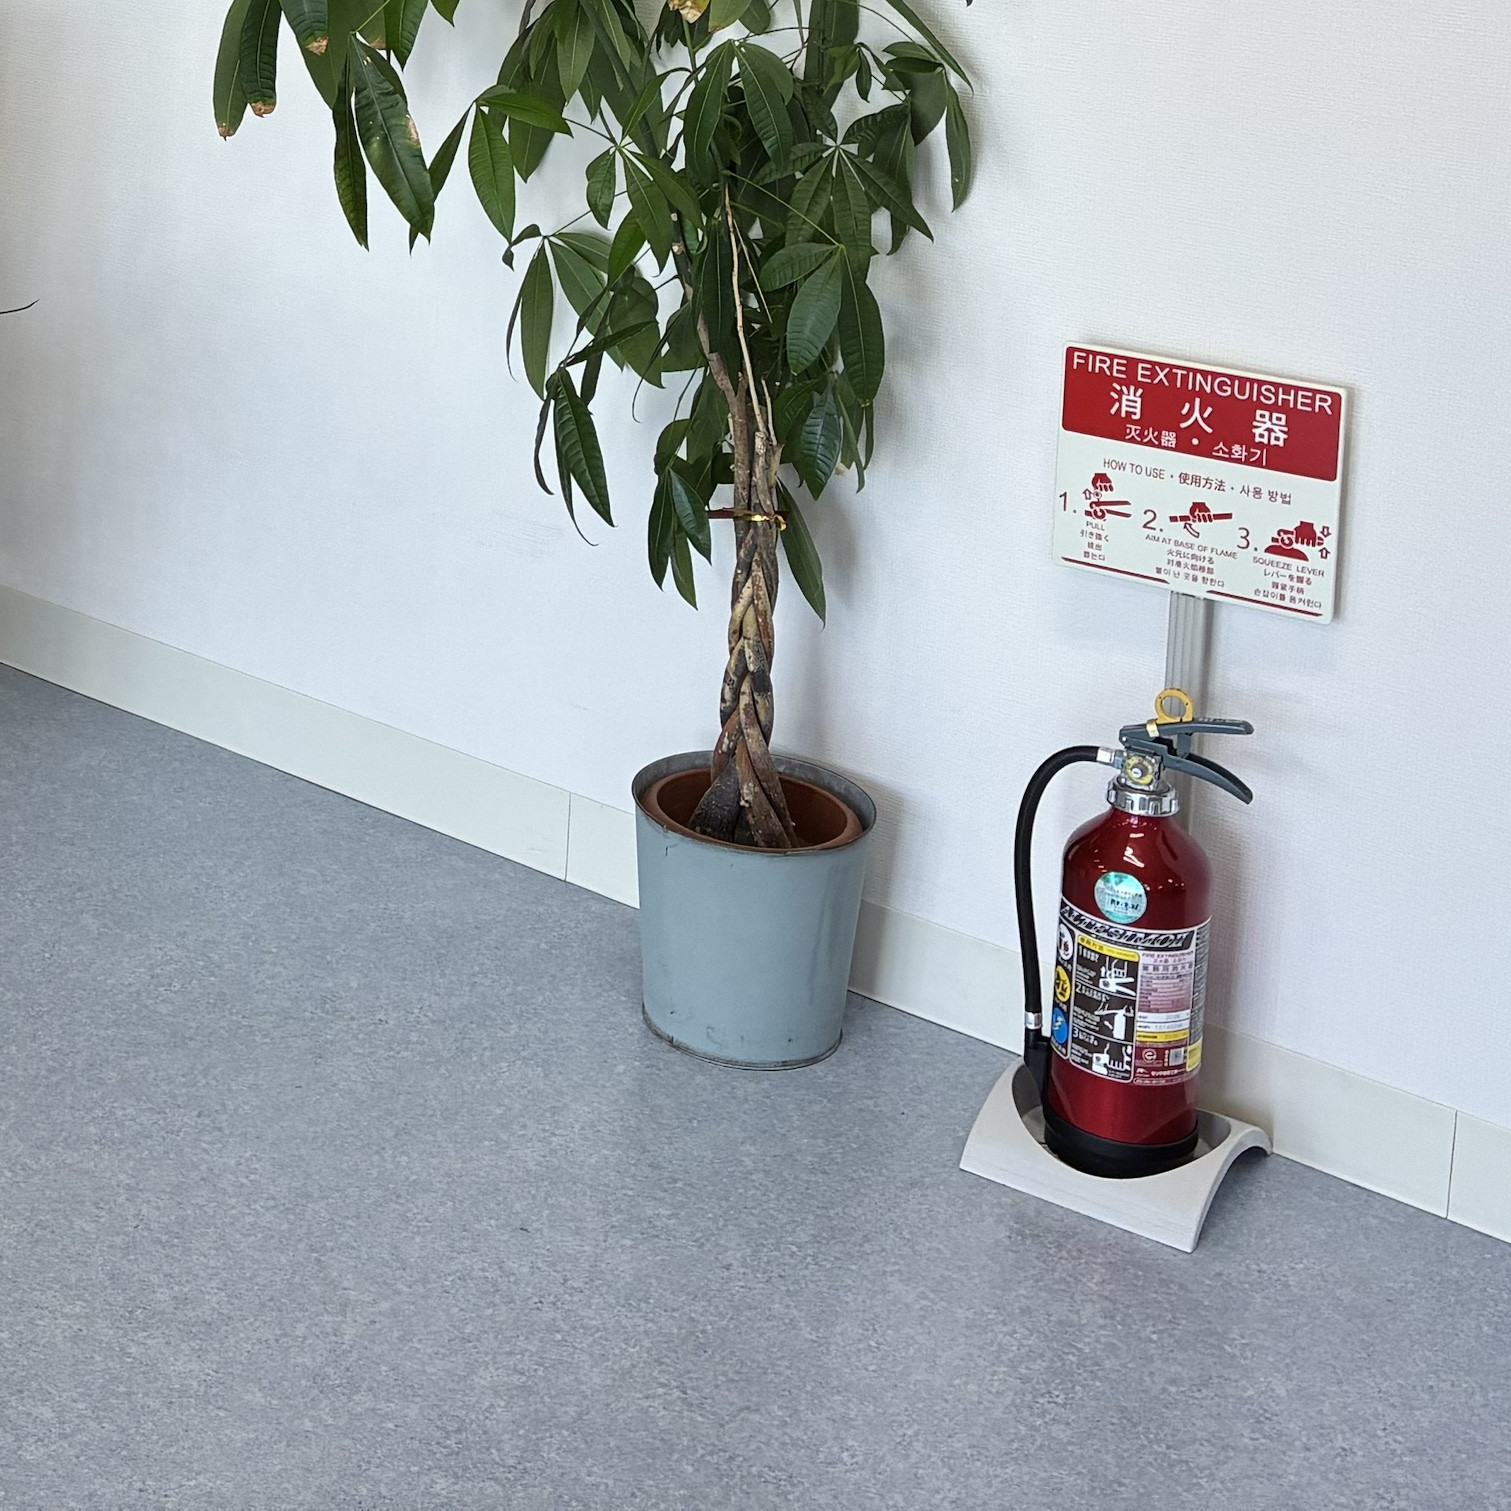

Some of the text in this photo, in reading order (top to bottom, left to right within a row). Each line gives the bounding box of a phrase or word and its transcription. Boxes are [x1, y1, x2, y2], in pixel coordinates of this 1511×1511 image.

[1072, 351, 1333, 415] FIRE EXTINGUISHER
[1109, 382, 1289, 448] 消火器
[1125, 424, 1177, 449] 灭火器
[1212, 441, 1267, 466] 소화기
[1103, 458, 1166, 480] HOW TO USE
[1178, 472, 1226, 492] 使用方法
[1240, 484, 1292, 506] 사용 방법
[1086, 520, 1105, 531] PULL
[1145, 534, 1238, 559] AIM AT BASE OF FLAME
[1252, 556, 1325, 578] SQUEEZE LEVER
